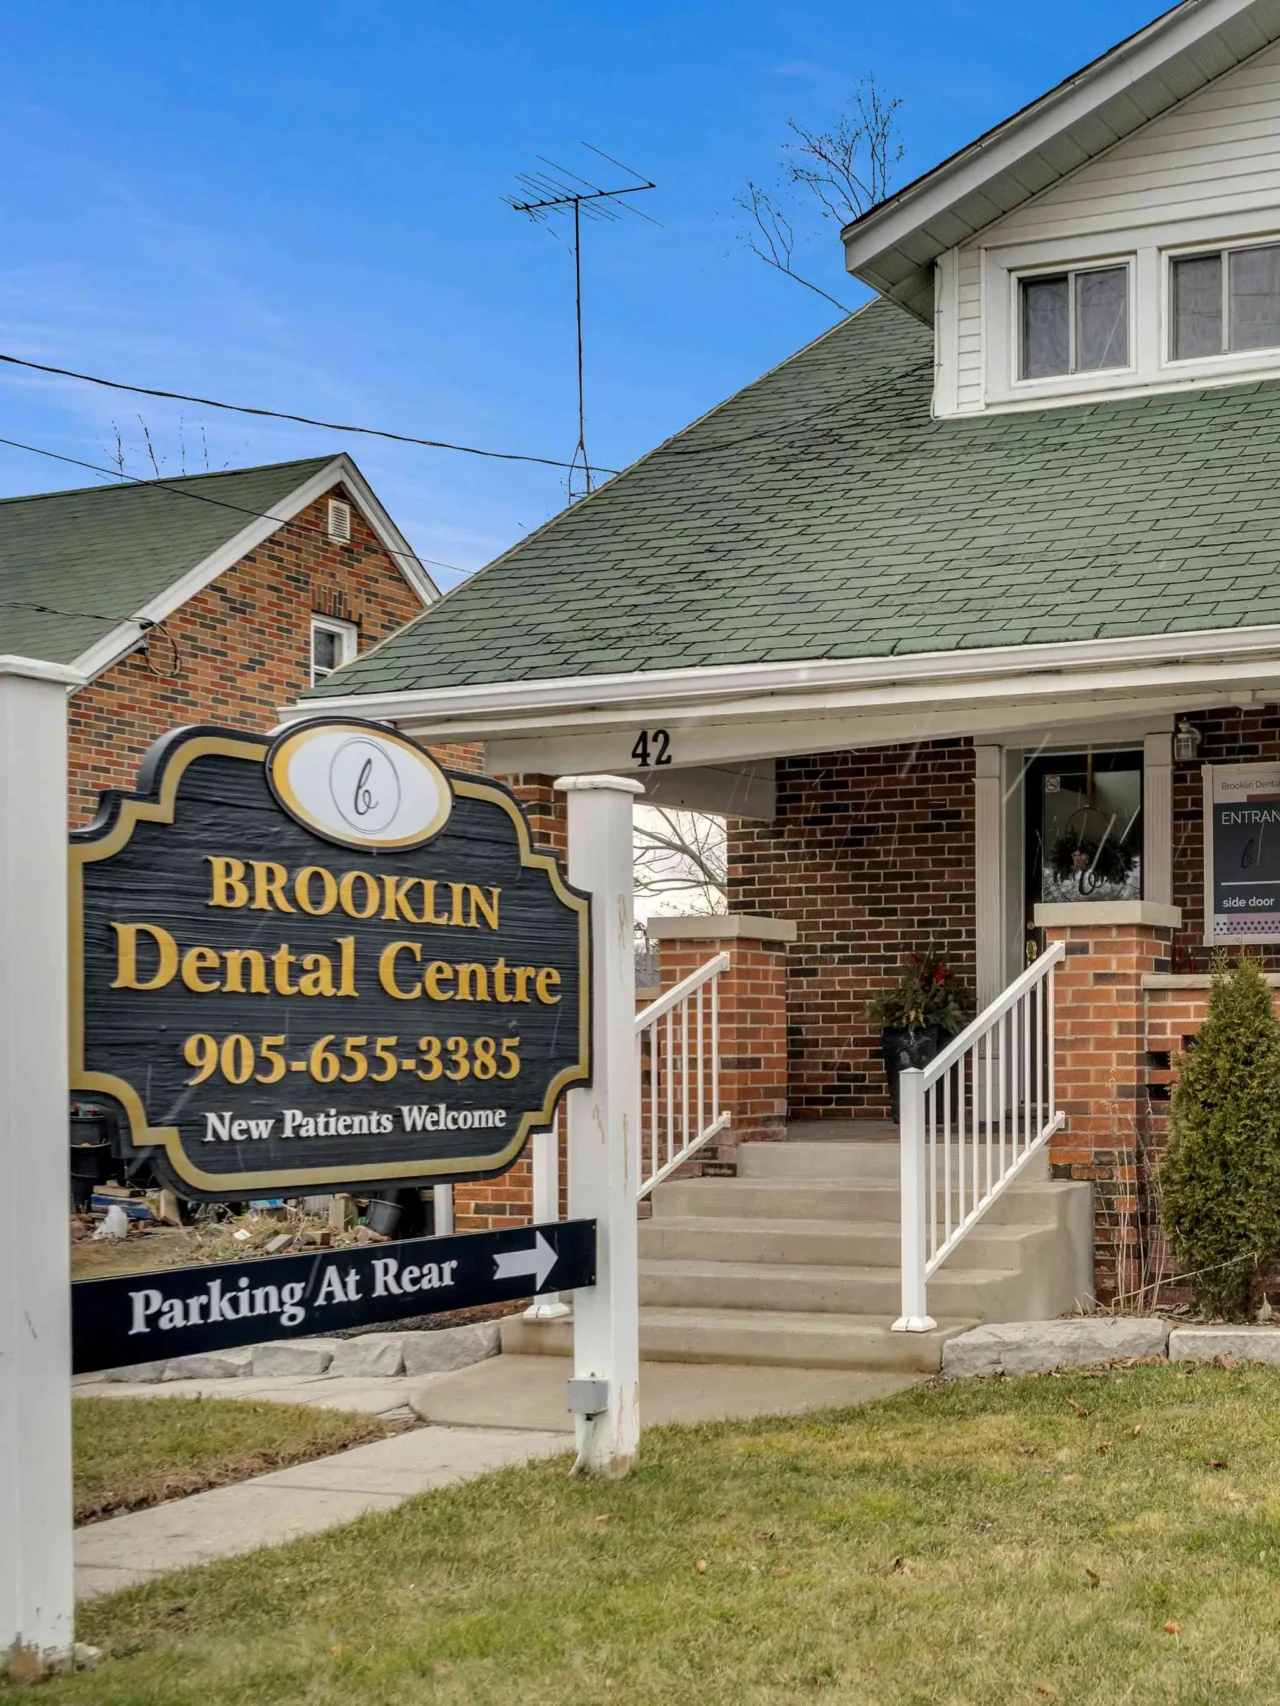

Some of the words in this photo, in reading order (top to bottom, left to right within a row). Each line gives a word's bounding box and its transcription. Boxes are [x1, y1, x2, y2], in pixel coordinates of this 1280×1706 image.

[631, 729, 672, 768] 42
[1221, 782, 1254, 791] Brooklin
[203, 855, 502, 930] BROOKLIN
[1222, 896, 1246, 908] side
[1248, 896, 1276, 907] door
[109, 921, 360, 998] Dental
[378, 941, 562, 1005] Centre
[182, 1033, 522, 1087] 905-655-3385
[202, 1111, 275, 1143] New
[279, 1107, 394, 1139] Patients
[396, 1102, 507, 1132] Welcome
[127, 1275, 307, 1336] Parking
[313, 1264, 362, 1307] At
[370, 1257, 458, 1298] Rear
